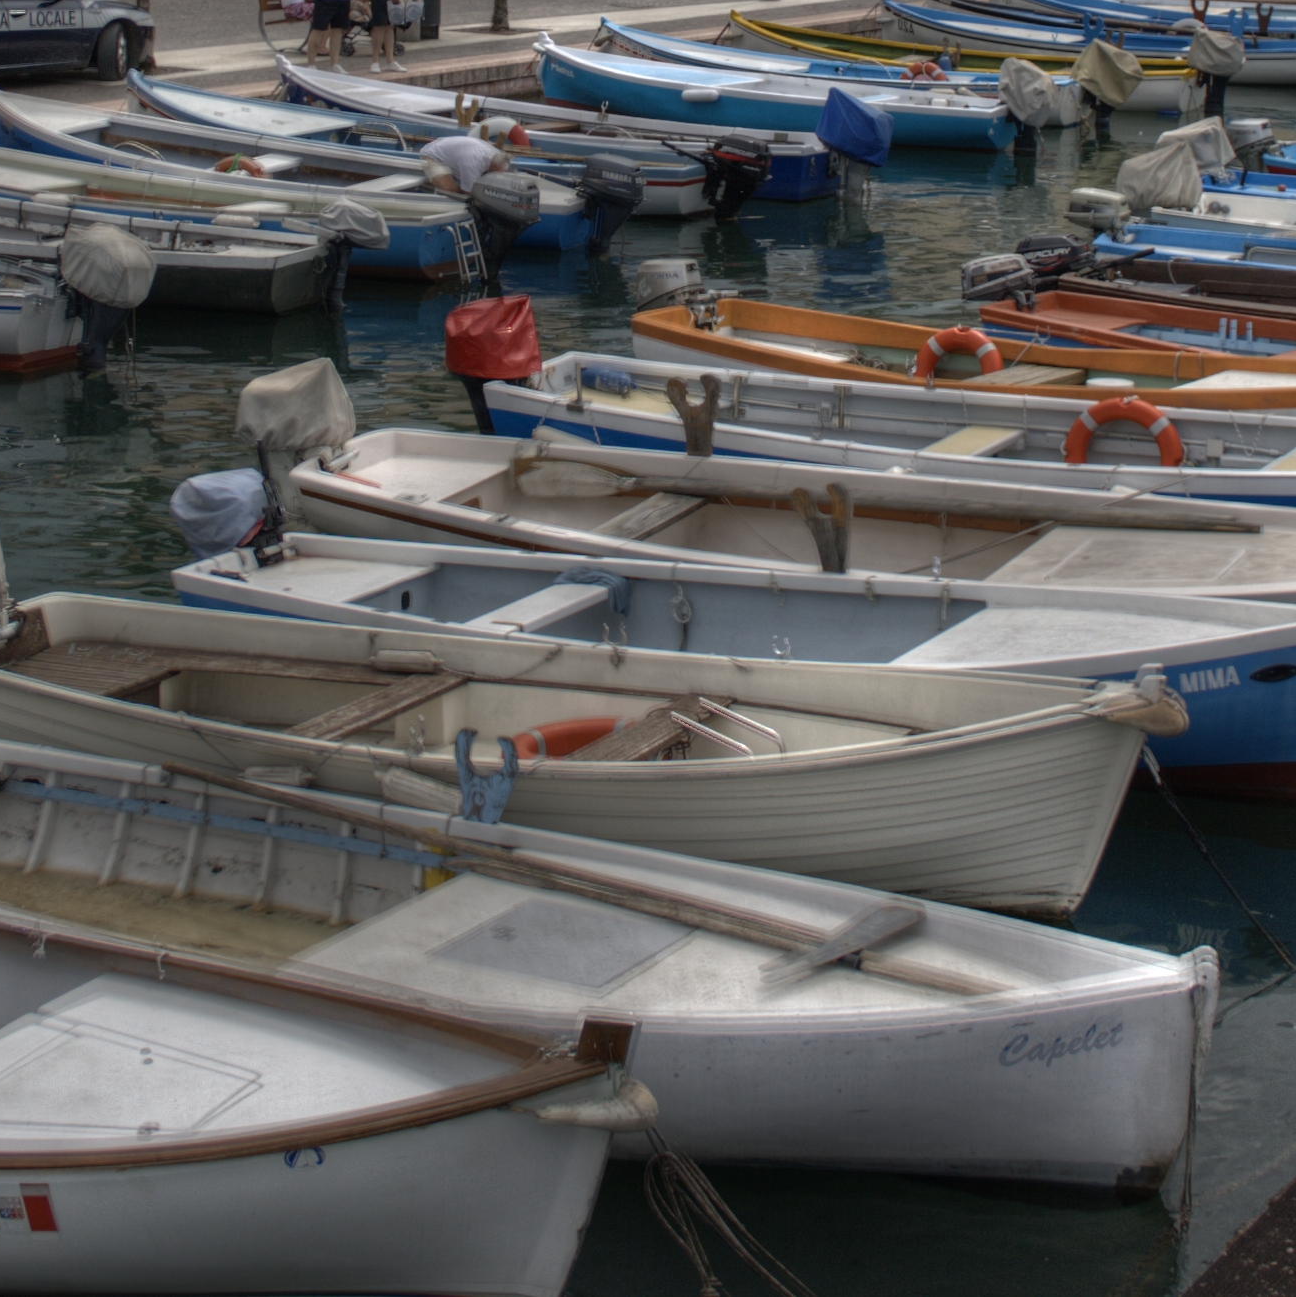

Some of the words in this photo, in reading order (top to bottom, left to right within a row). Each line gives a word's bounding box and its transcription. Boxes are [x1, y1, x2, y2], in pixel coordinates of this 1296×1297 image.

[29, 10, 76, 27] LOCALE
[1179, 665, 1241, 694] MIMA
[998, 1022, 1123, 1068] Capelet
